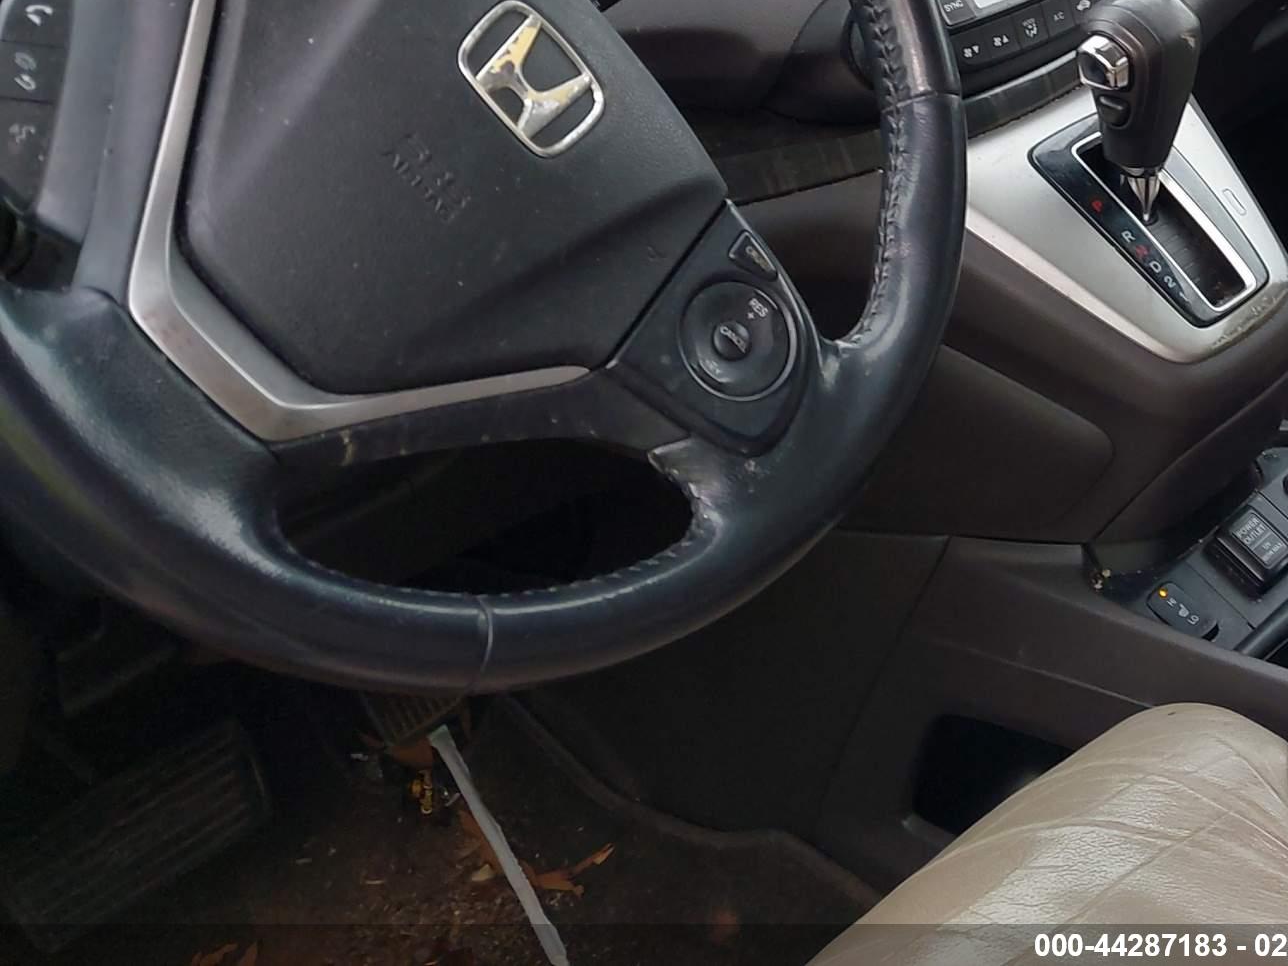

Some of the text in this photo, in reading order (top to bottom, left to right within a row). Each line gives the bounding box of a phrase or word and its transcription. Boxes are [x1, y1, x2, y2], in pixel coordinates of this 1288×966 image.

[943, 0, 964, 13] SYNC
[1121, 230, 1136, 243] R
[1149, 260, 1161, 273] D
[1164, 275, 1177, 288] 2
[748, 297, 769, 317] RES
[1235, 517, 1260, 538] POWER
[1243, 523, 1266, 545] OUTLET
[1187, 615, 1199, 625] LO
